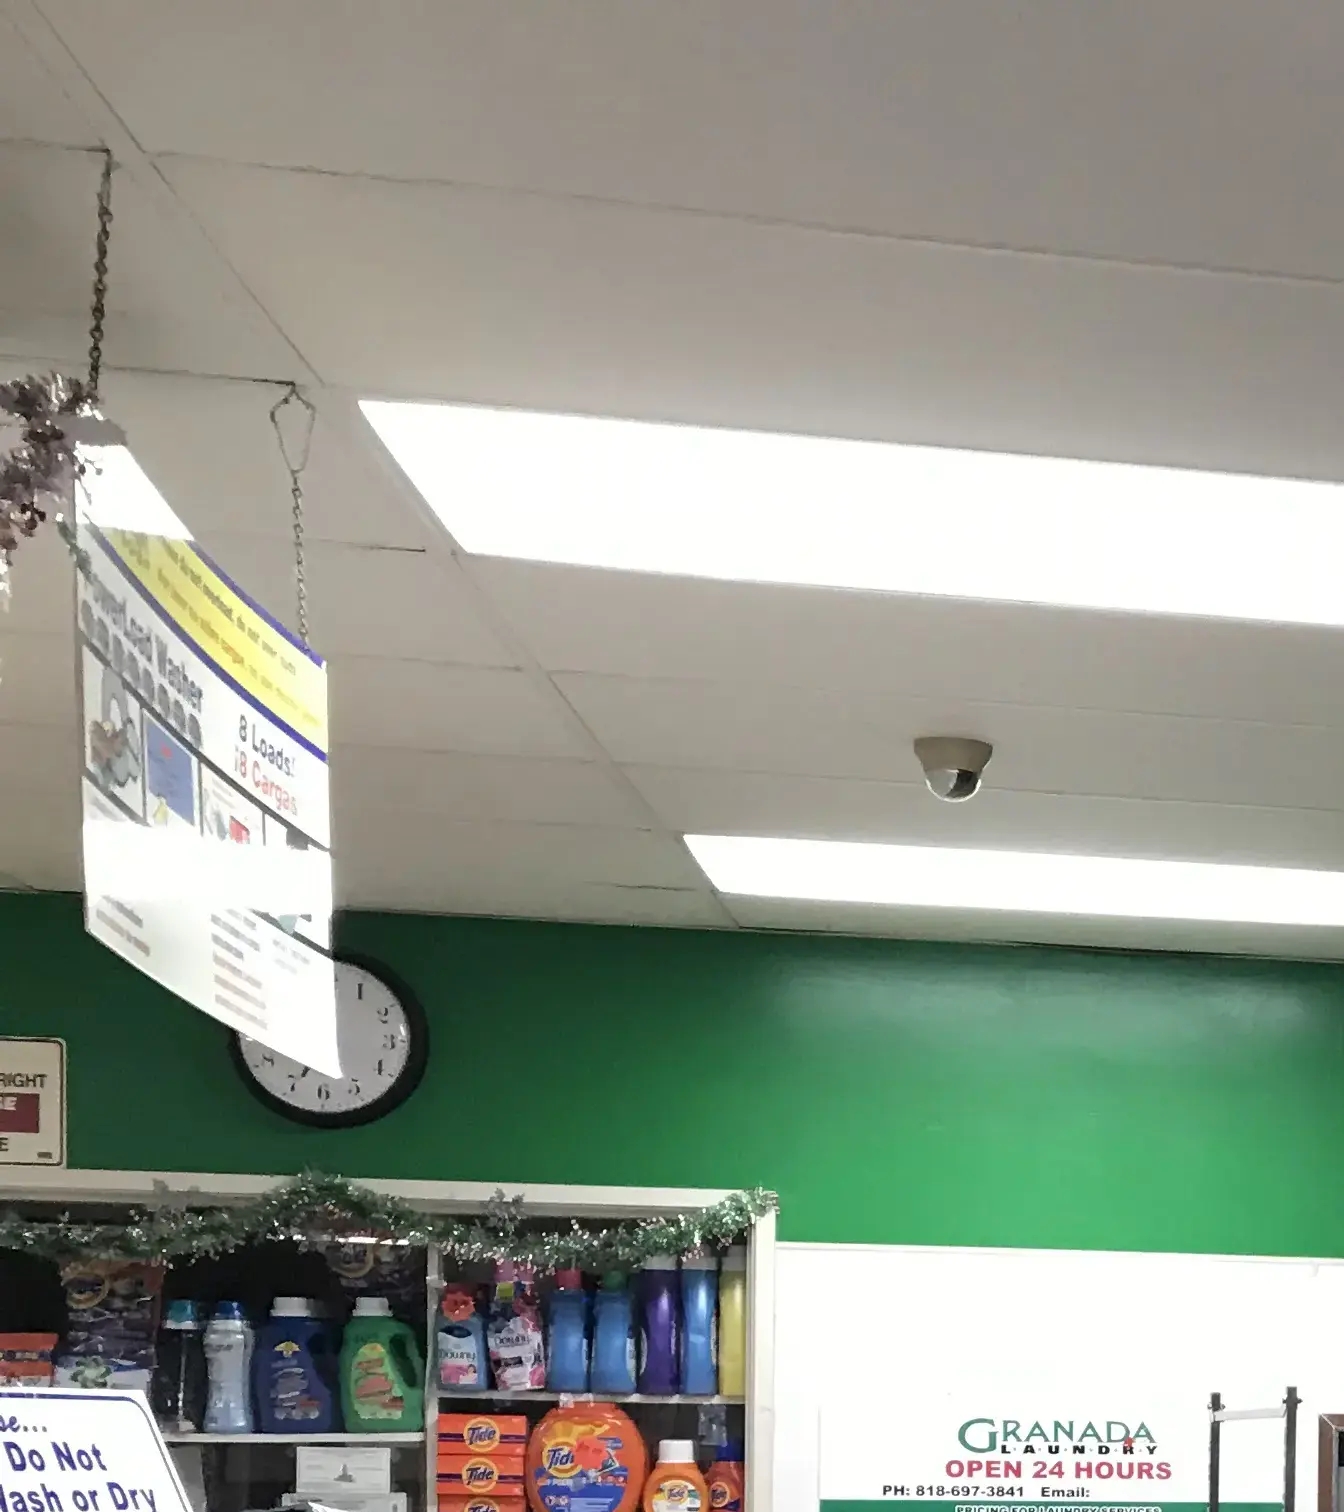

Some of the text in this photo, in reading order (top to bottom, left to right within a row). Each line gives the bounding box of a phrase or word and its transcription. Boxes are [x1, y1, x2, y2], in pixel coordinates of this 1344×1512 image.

[238, 714, 248, 743] 8
[467, 1426, 497, 1445] Tide
[957, 1417, 1157, 1454] GRANADA
[2, 1440, 108, 1472] Do Not
[547, 1447, 574, 1469] Tid
[466, 1466, 495, 1485] Tide
[945, 1459, 1172, 1481] OPEN 24 HOURS
[71, 1489, 100, 1512] or
[882, 1485, 1091, 1499] PH: 818-697-3841 Email:
